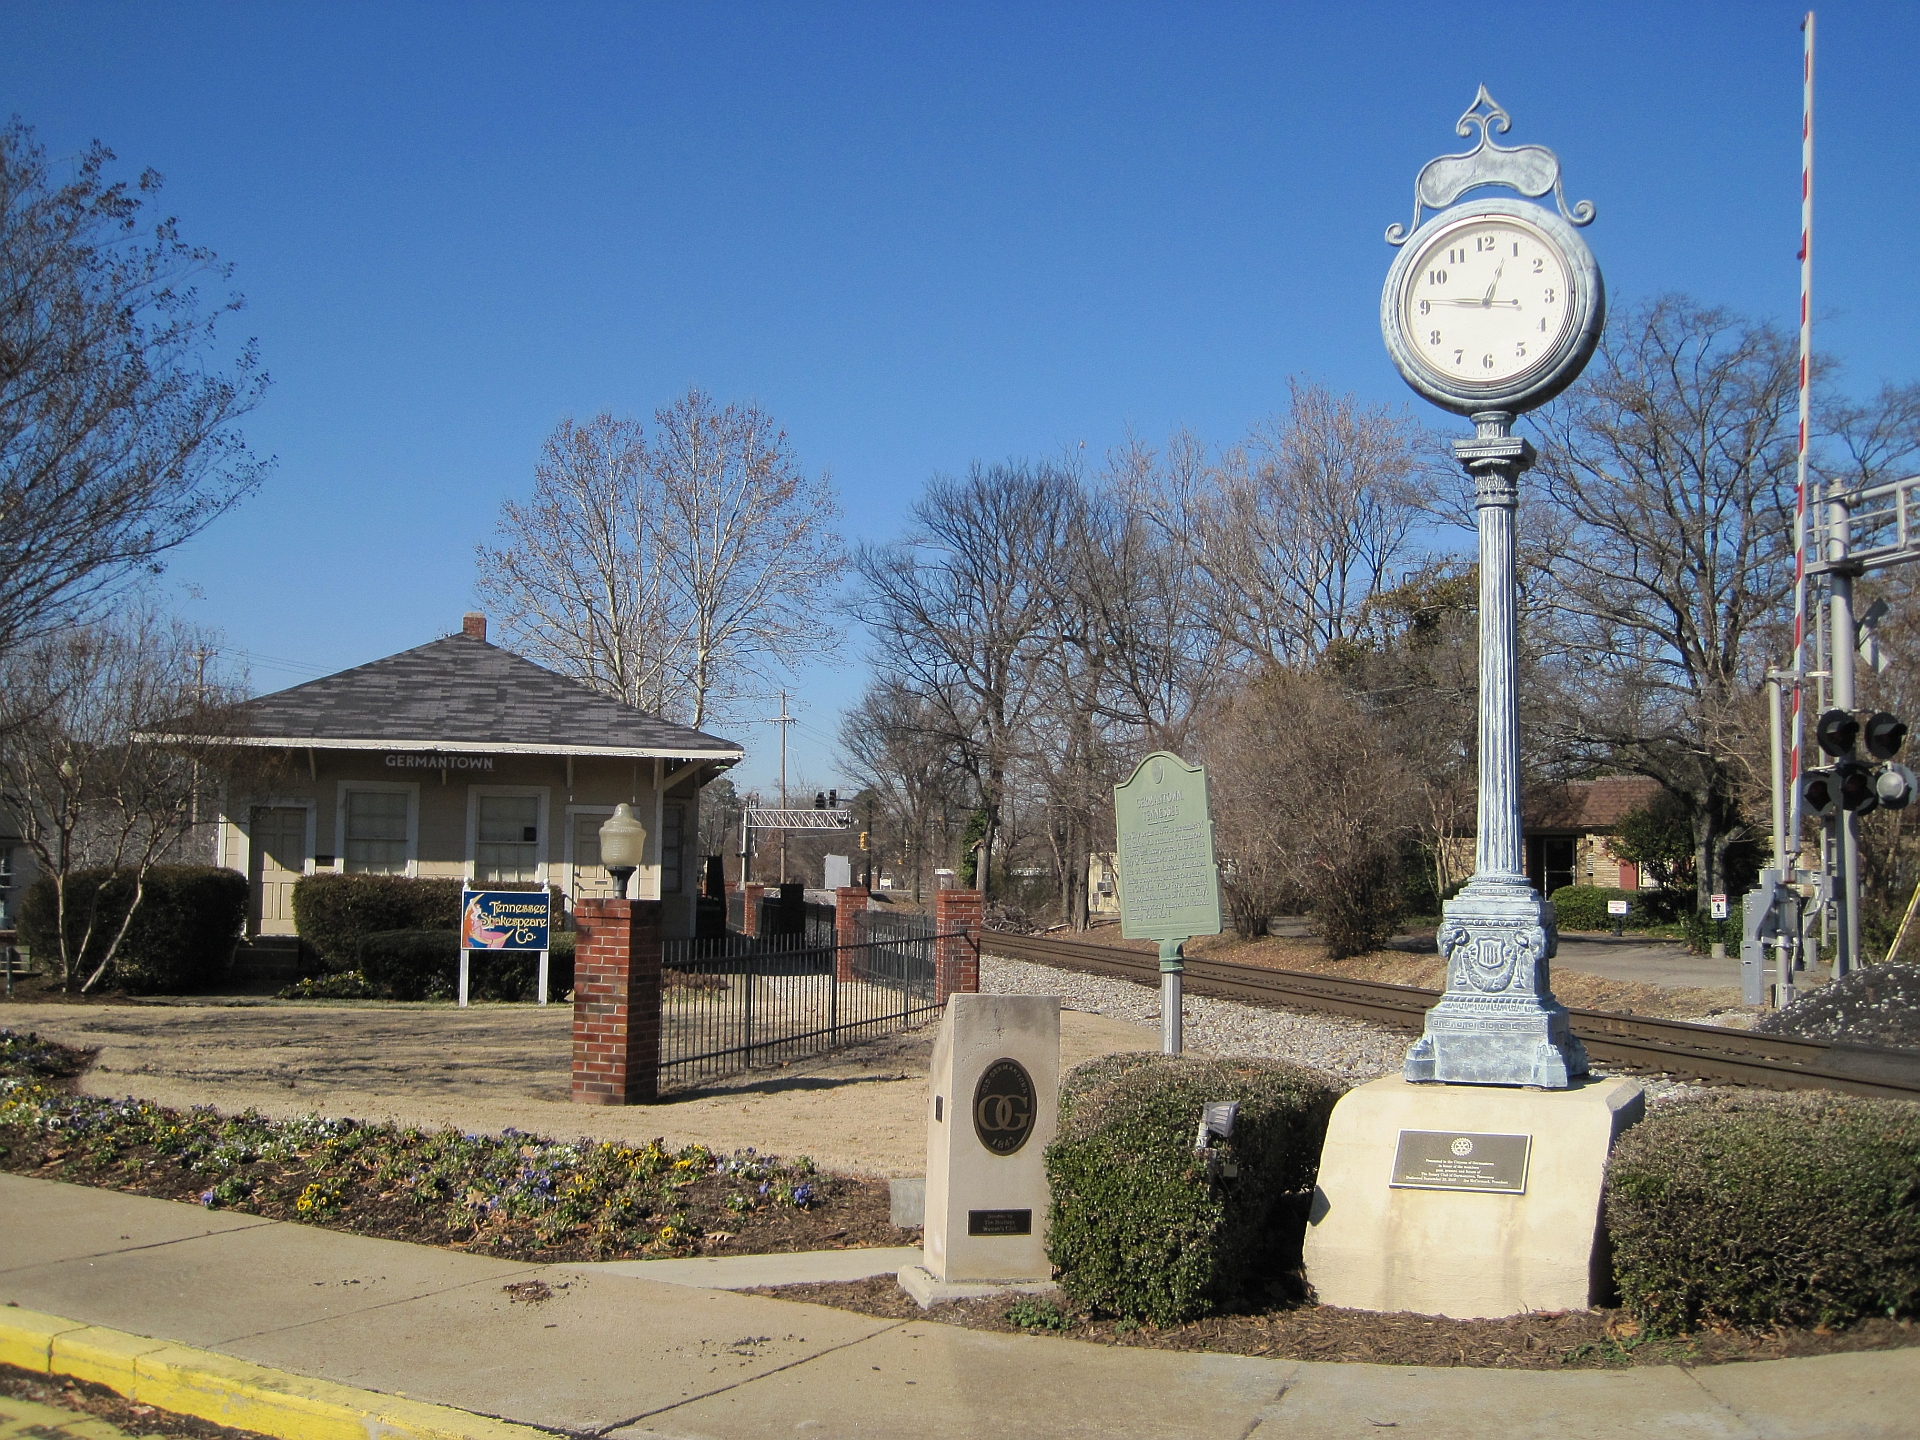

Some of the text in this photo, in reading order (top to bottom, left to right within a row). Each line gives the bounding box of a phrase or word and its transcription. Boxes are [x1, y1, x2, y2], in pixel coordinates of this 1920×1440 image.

[1476, 236, 1496, 252] 12
[1513, 242, 1518, 257] 1
[1448, 248, 1466, 264] 11
[1532, 258, 1544, 274] 2
[1428, 269, 1448, 286] 10
[1544, 288, 1555, 304] 3
[1419, 300, 1431, 316] 9
[1536, 316, 1547, 332] 4
[1430, 330, 1442, 346] 8
[1453, 348, 1464, 364] 7
[1516, 341, 1526, 357] 5
[1482, 353, 1494, 369] 6
[386, 754, 493, 770] GERMANTOWN
[489, 900, 547, 916] Tennessee
[480, 912, 547, 930] Shakespeare
[515, 928, 536, 944] Co.
[982, 1064, 1028, 1094] OLD GERMANTOWN
[978, 1094, 1030, 1131] OG
